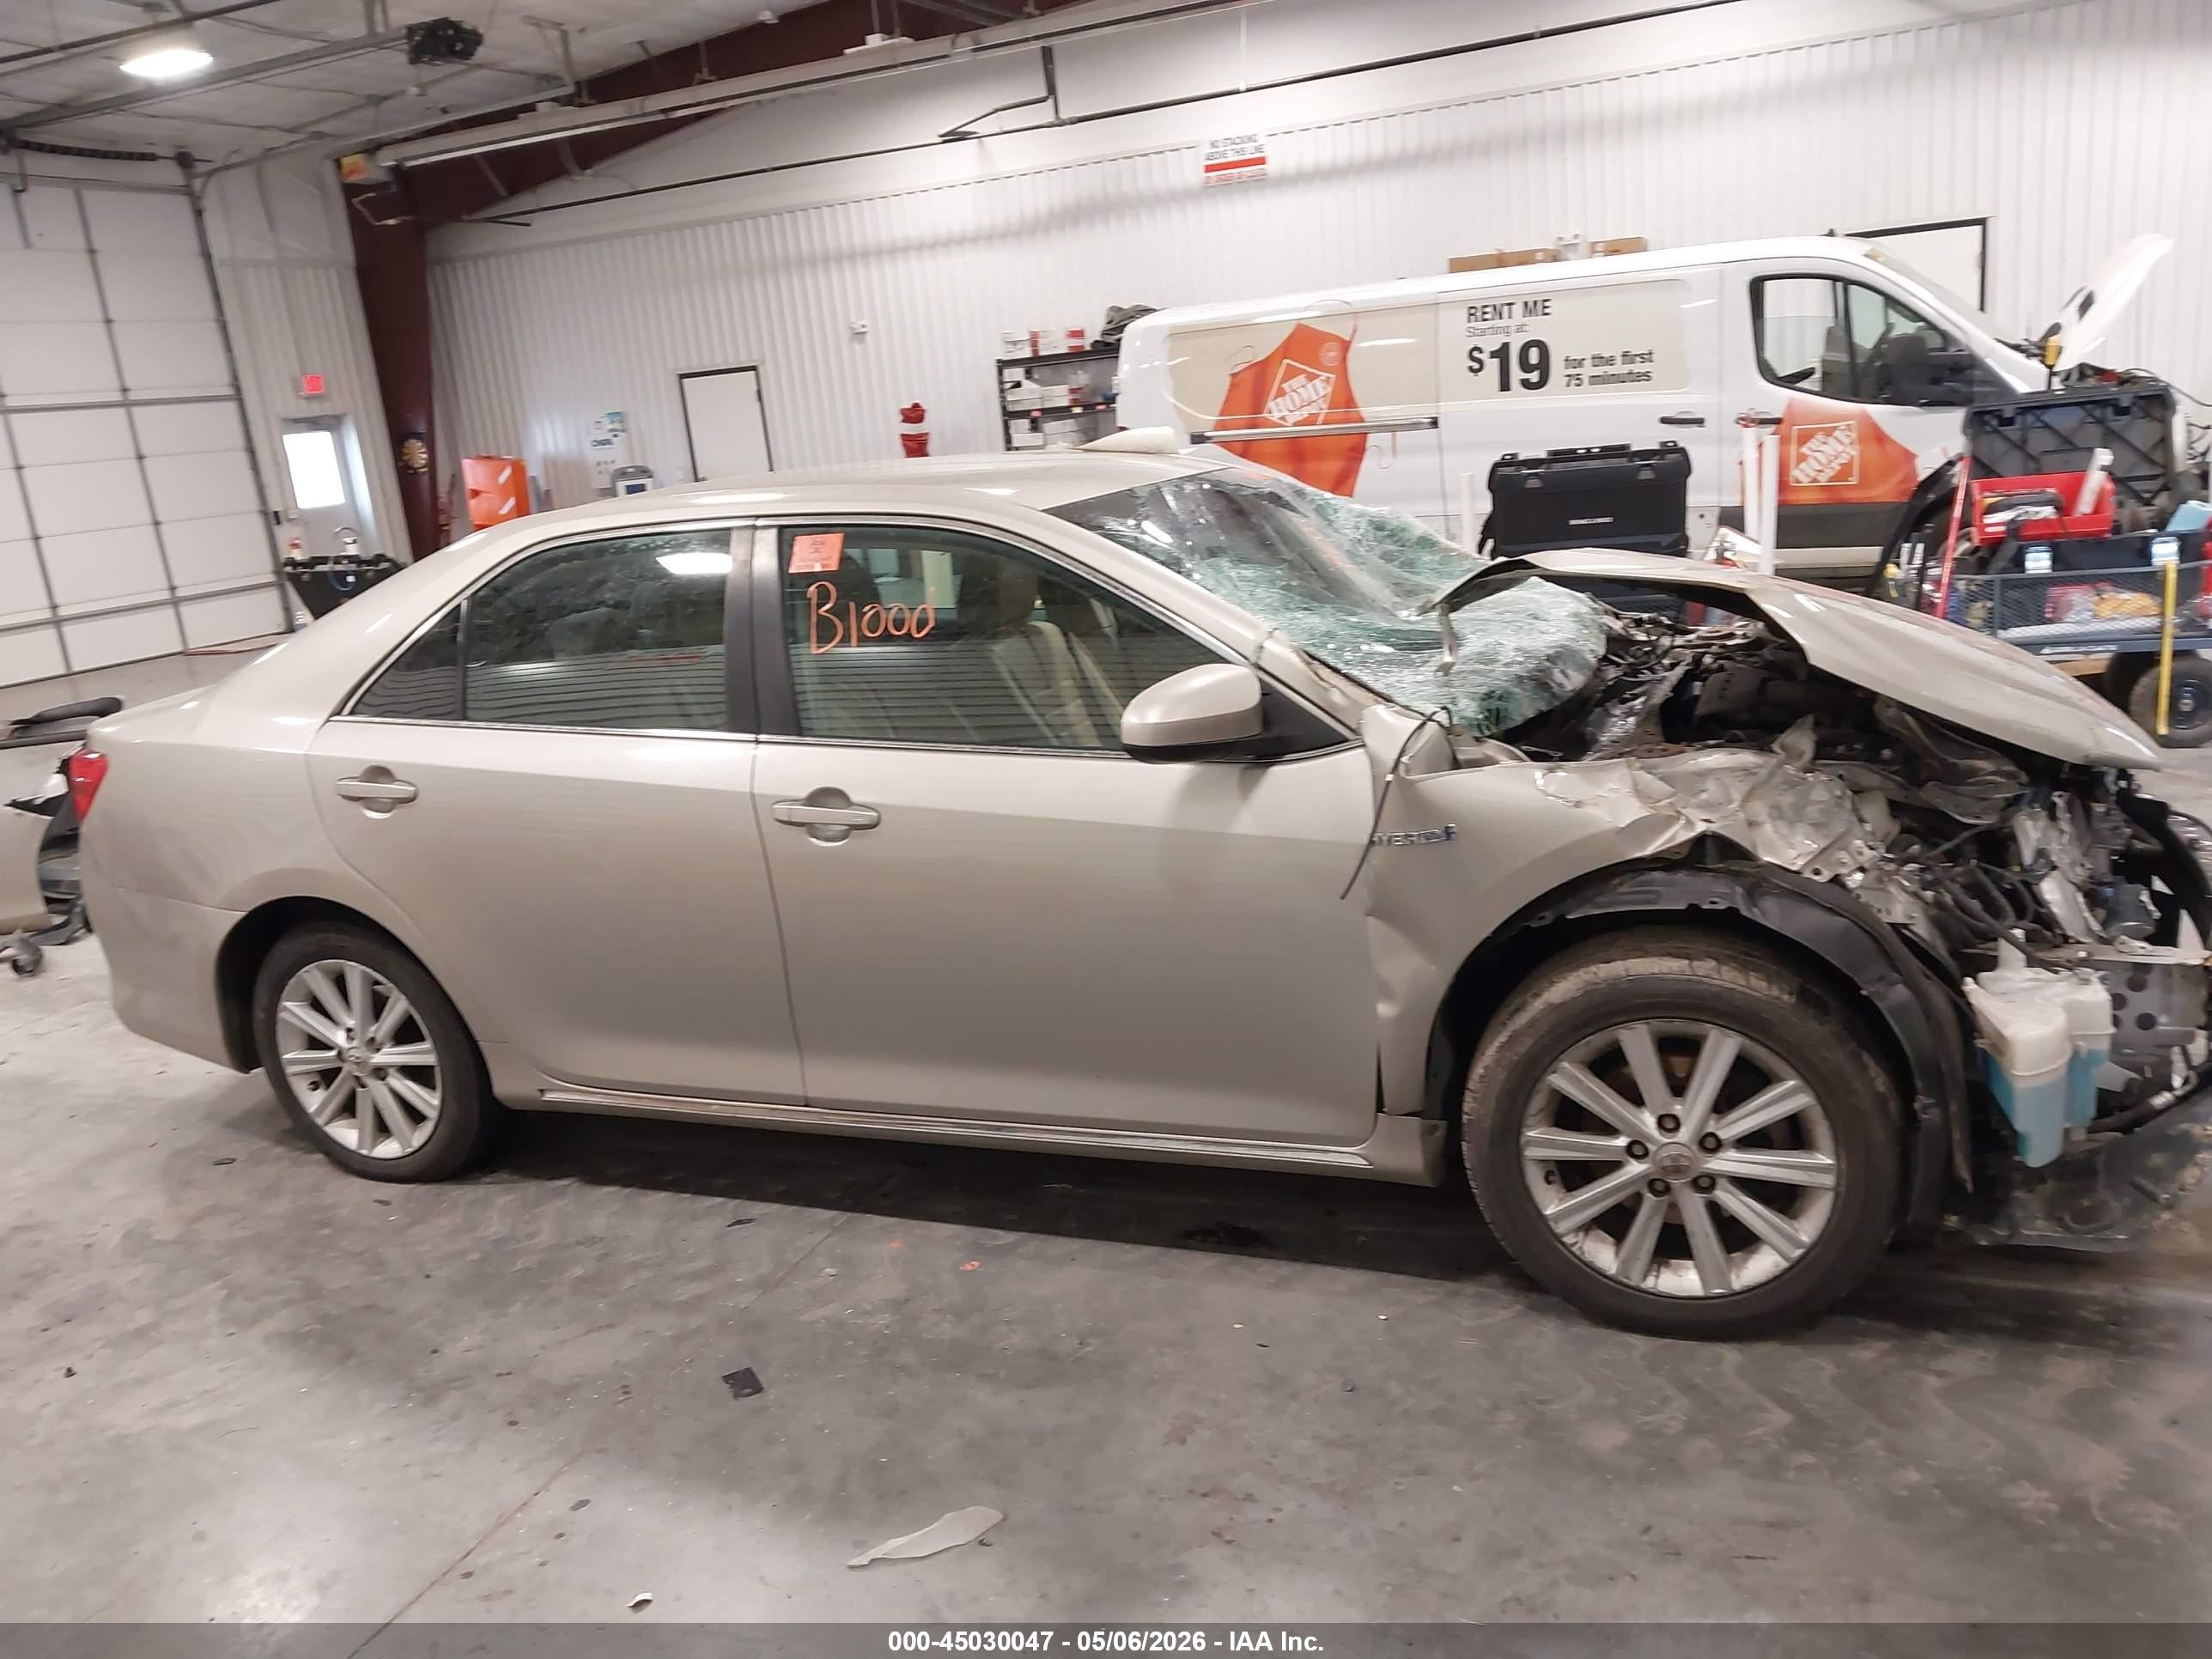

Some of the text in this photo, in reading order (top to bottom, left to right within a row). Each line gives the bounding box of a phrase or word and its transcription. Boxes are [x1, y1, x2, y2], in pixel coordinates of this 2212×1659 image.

[1467, 299, 1553, 323] RENT ME
[1466, 323, 1511, 337] Starting
[1468, 339, 1550, 392] $19
[1564, 349, 1655, 369] for the first
[1564, 369, 1654, 387] 75 minutes
[1267, 375, 1331, 419] HOME
[1792, 425, 1857, 483] HOME
